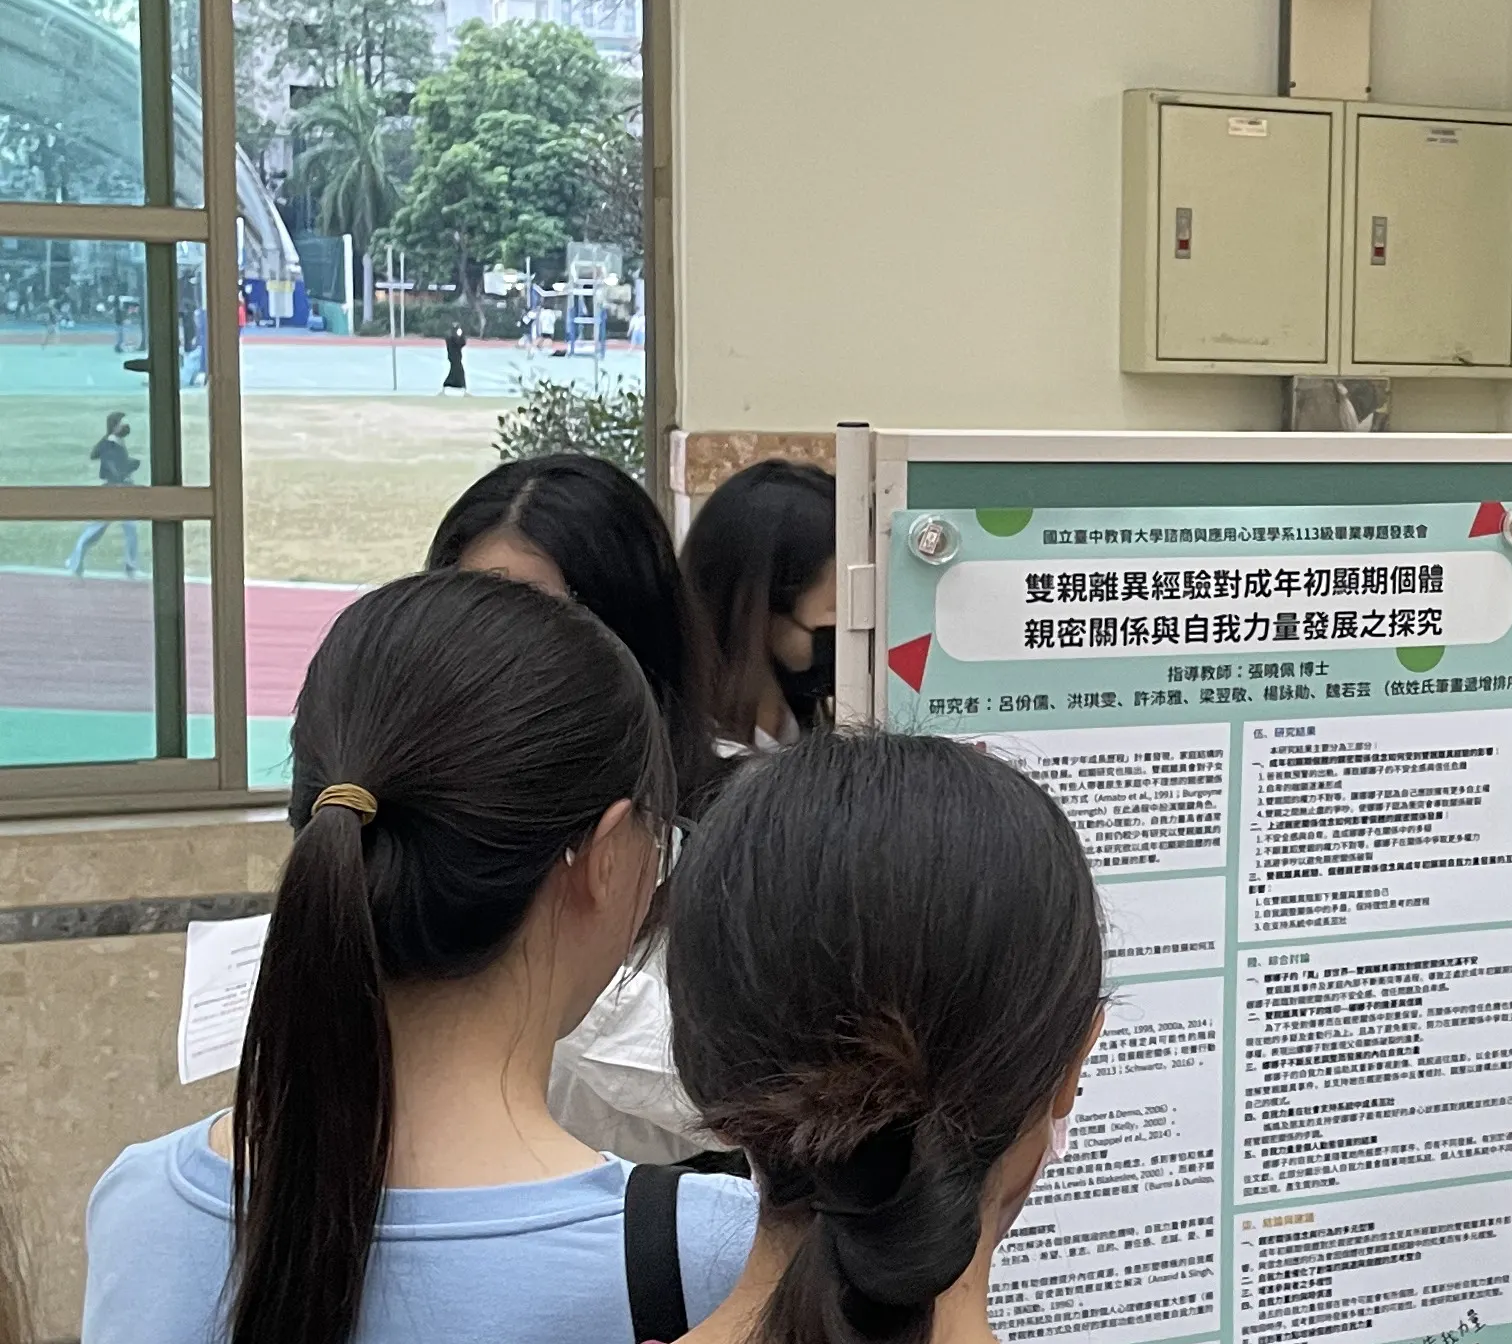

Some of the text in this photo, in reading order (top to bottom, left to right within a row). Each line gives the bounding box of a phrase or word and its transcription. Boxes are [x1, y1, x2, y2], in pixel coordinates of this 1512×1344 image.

[1025, 564, 1444, 603] 雙親離異經驗對成年初顯期個體
[1024, 608, 1443, 649] 親密關係與自我力量發展之探究
[1300, 661, 1330, 676] 博士
